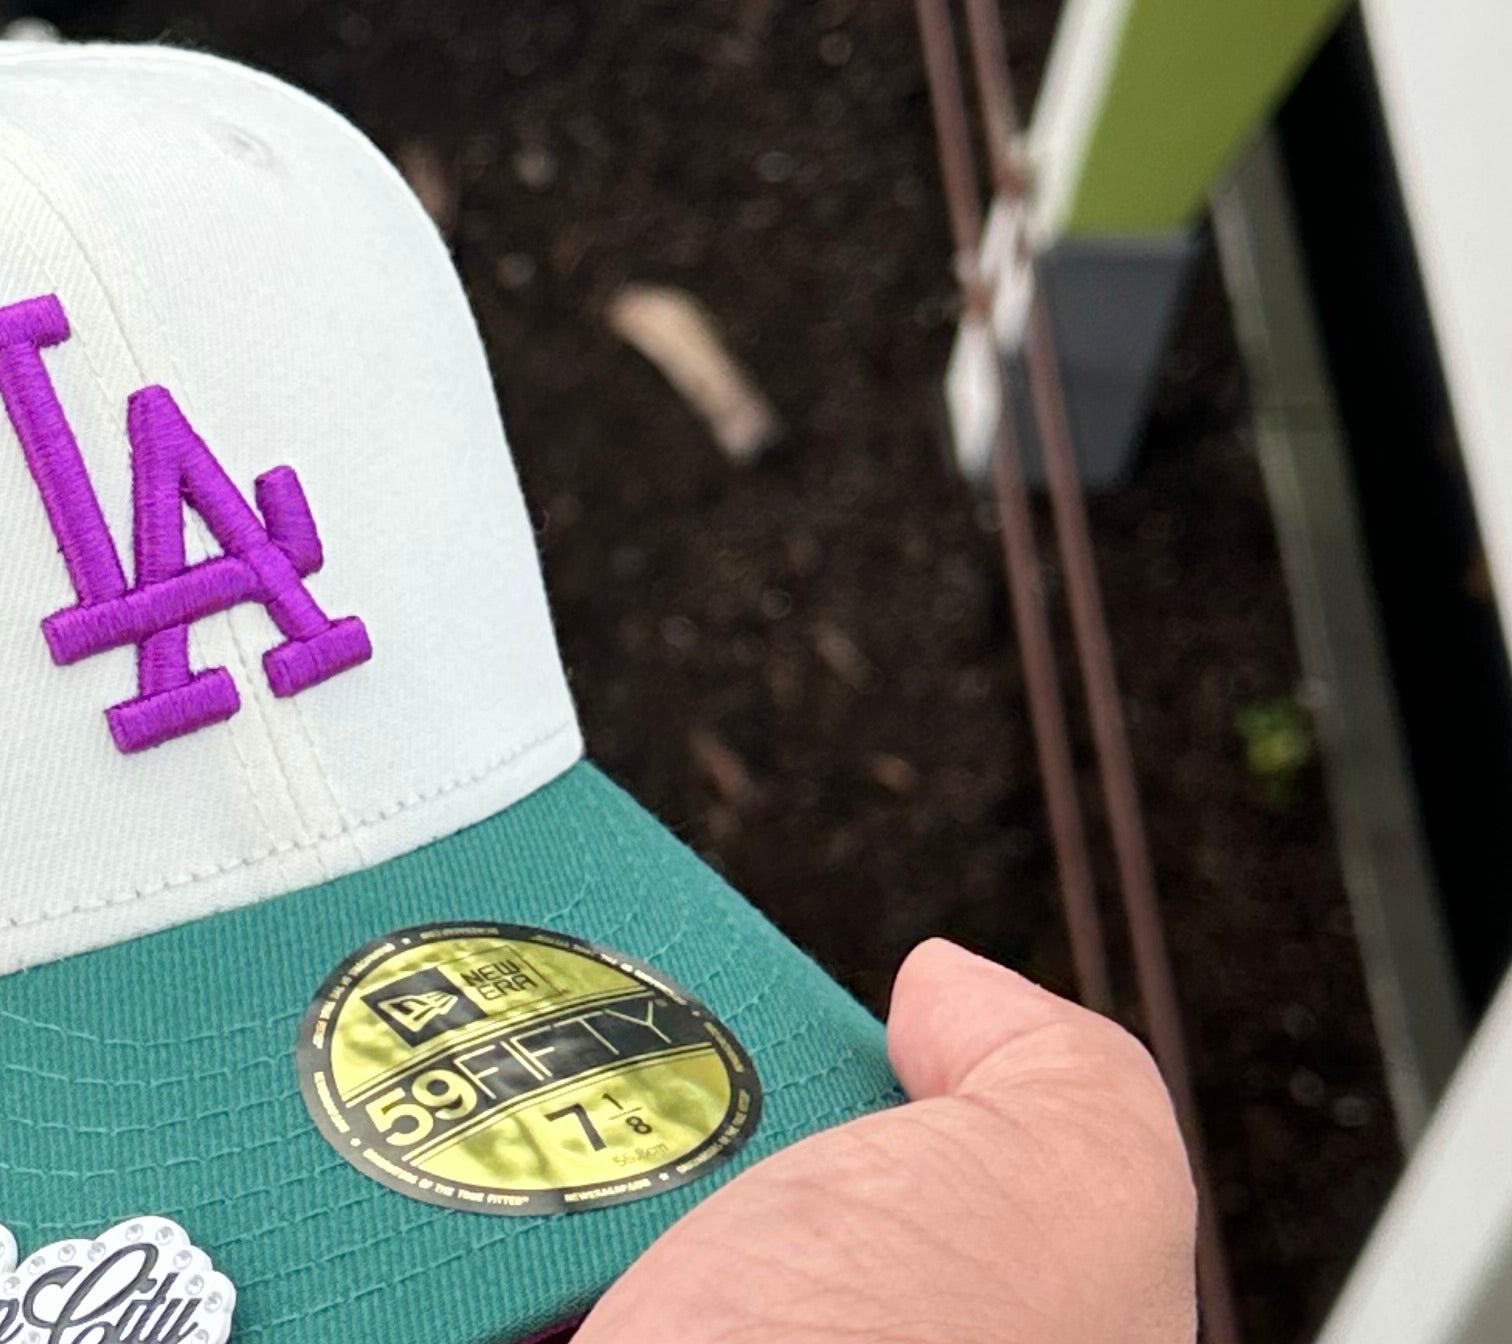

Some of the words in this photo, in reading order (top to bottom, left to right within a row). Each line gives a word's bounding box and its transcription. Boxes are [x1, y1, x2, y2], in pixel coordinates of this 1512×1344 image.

[460, 959, 521, 987] NEW
[477, 973, 538, 1001] ERA
[365, 1000, 672, 1146] 59FIFTY
[545, 1103, 607, 1152] 7
